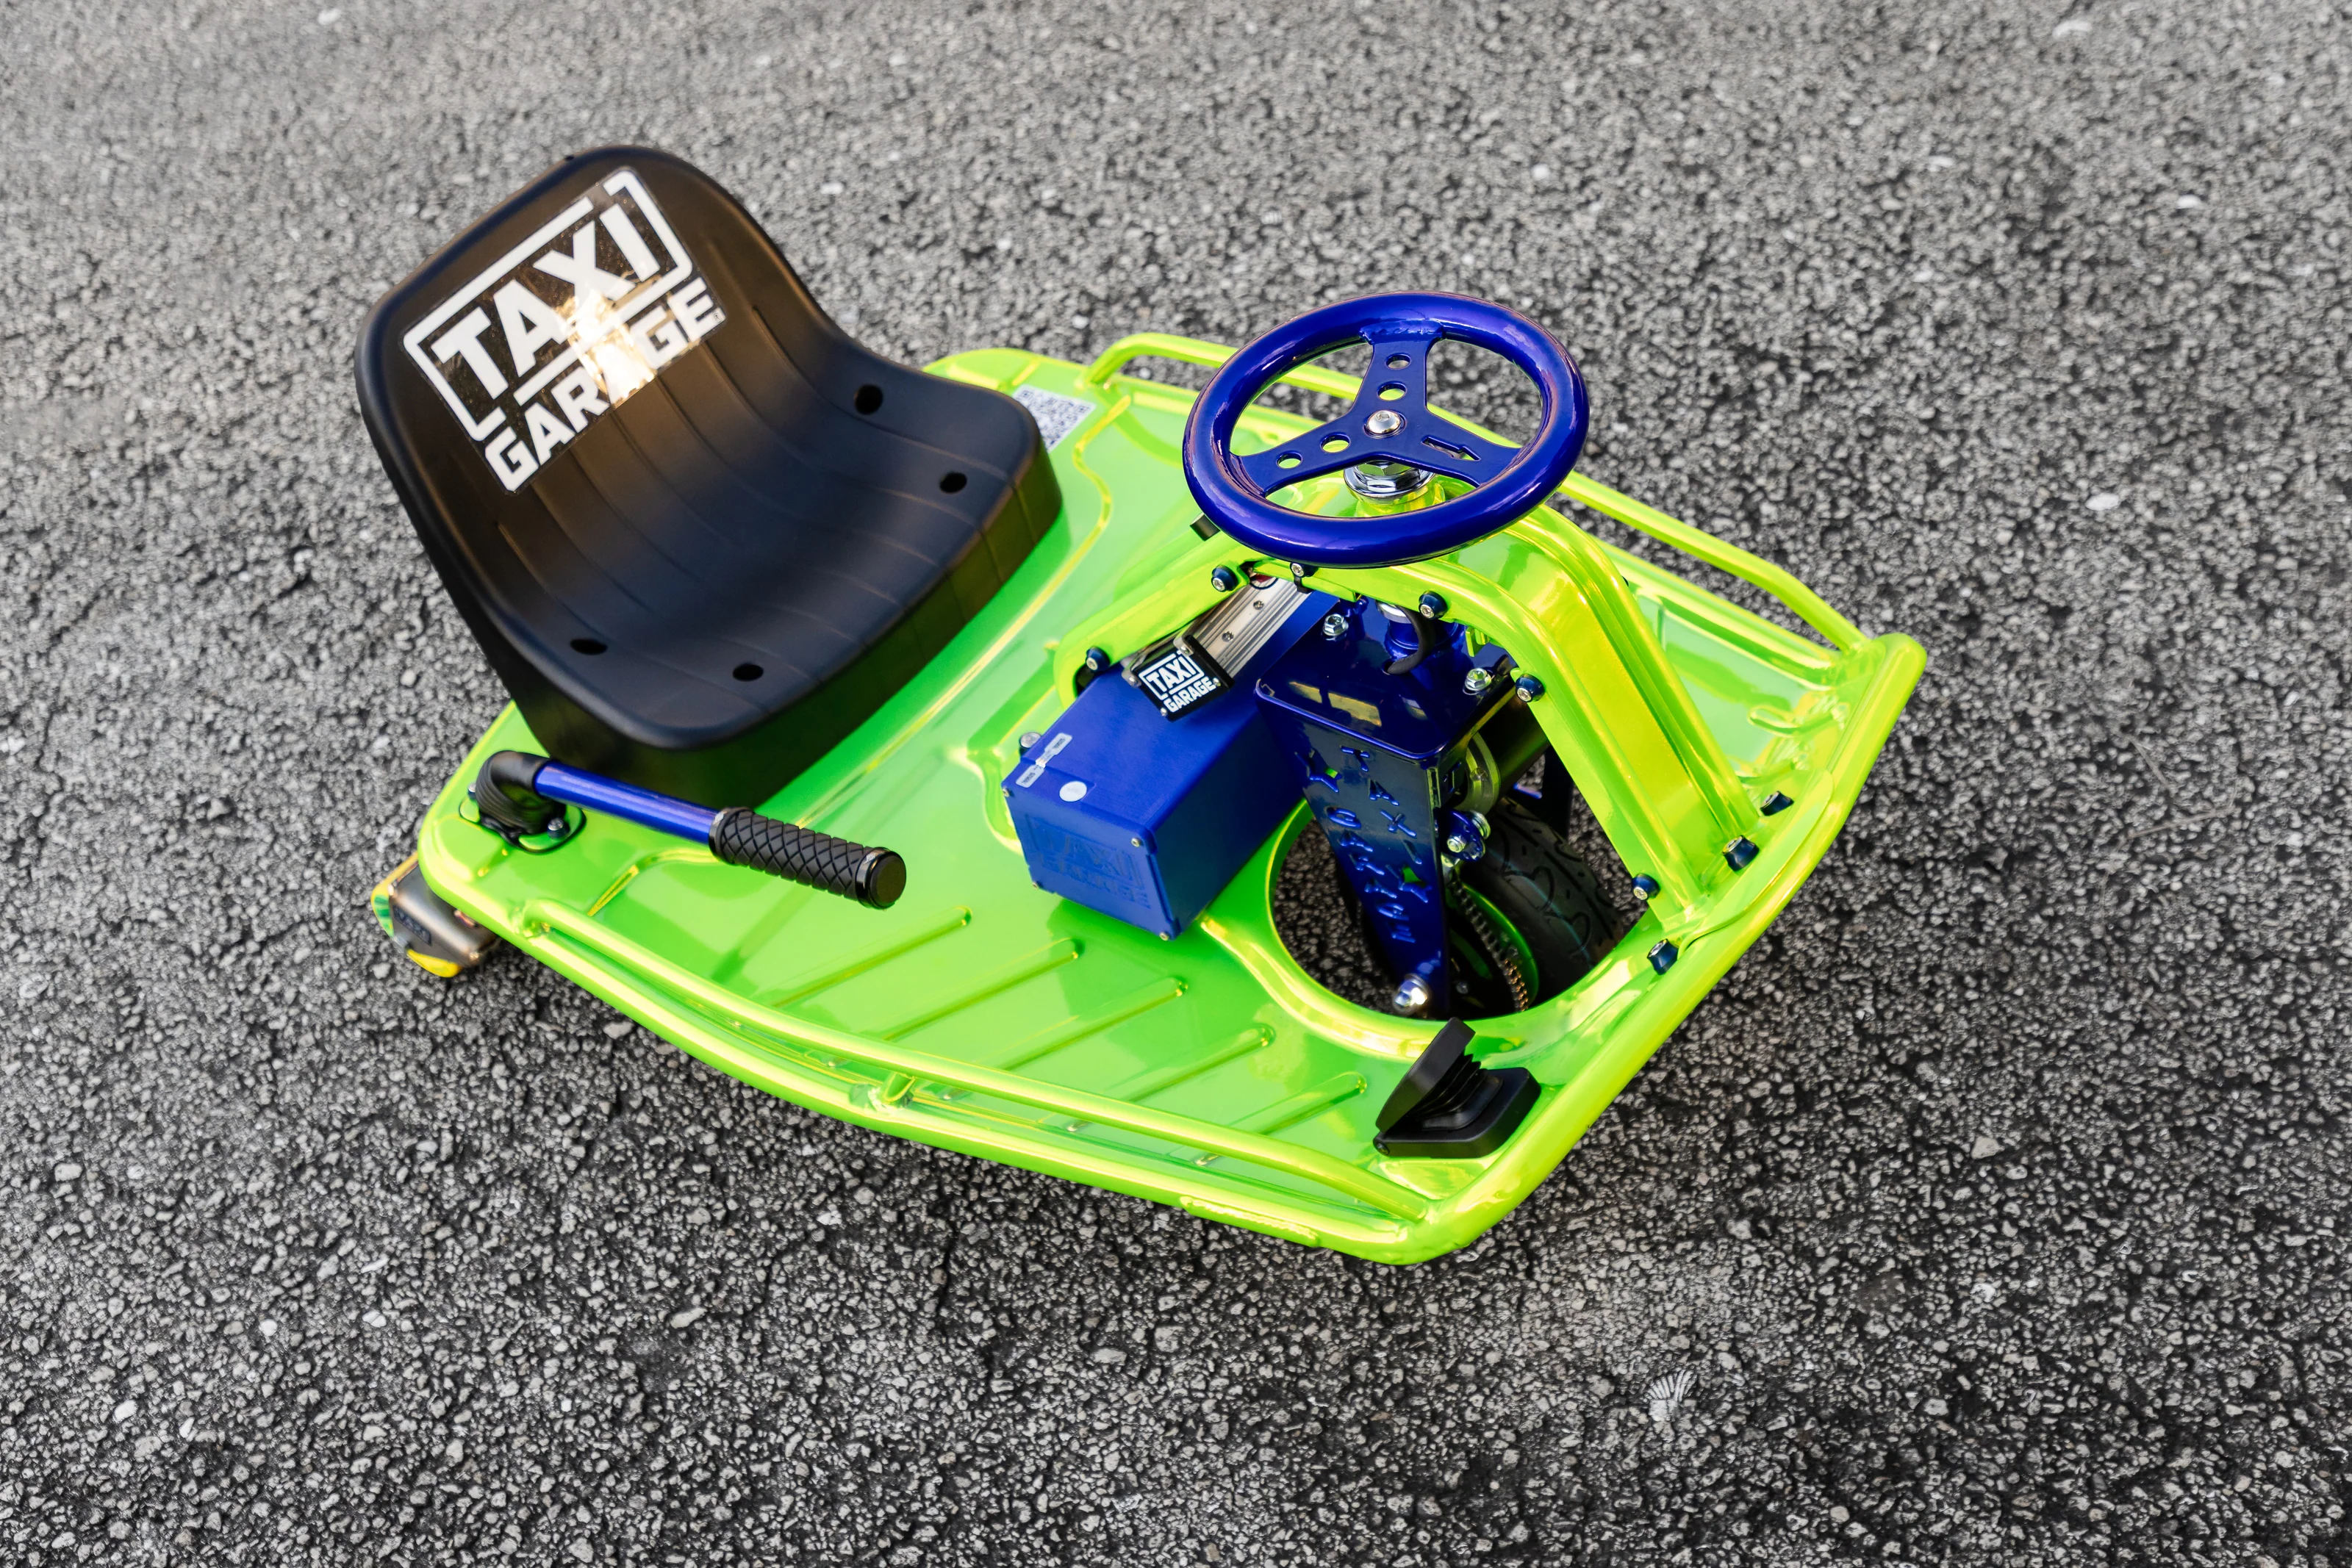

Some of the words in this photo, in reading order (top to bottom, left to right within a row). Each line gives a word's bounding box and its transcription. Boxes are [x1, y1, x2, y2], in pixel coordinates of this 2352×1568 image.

[430, 203, 660, 399] TAXI
[485, 276, 726, 493] GARAGE
[1145, 656, 1197, 692] TAXI
[1164, 676, 1216, 713] GARAGE
